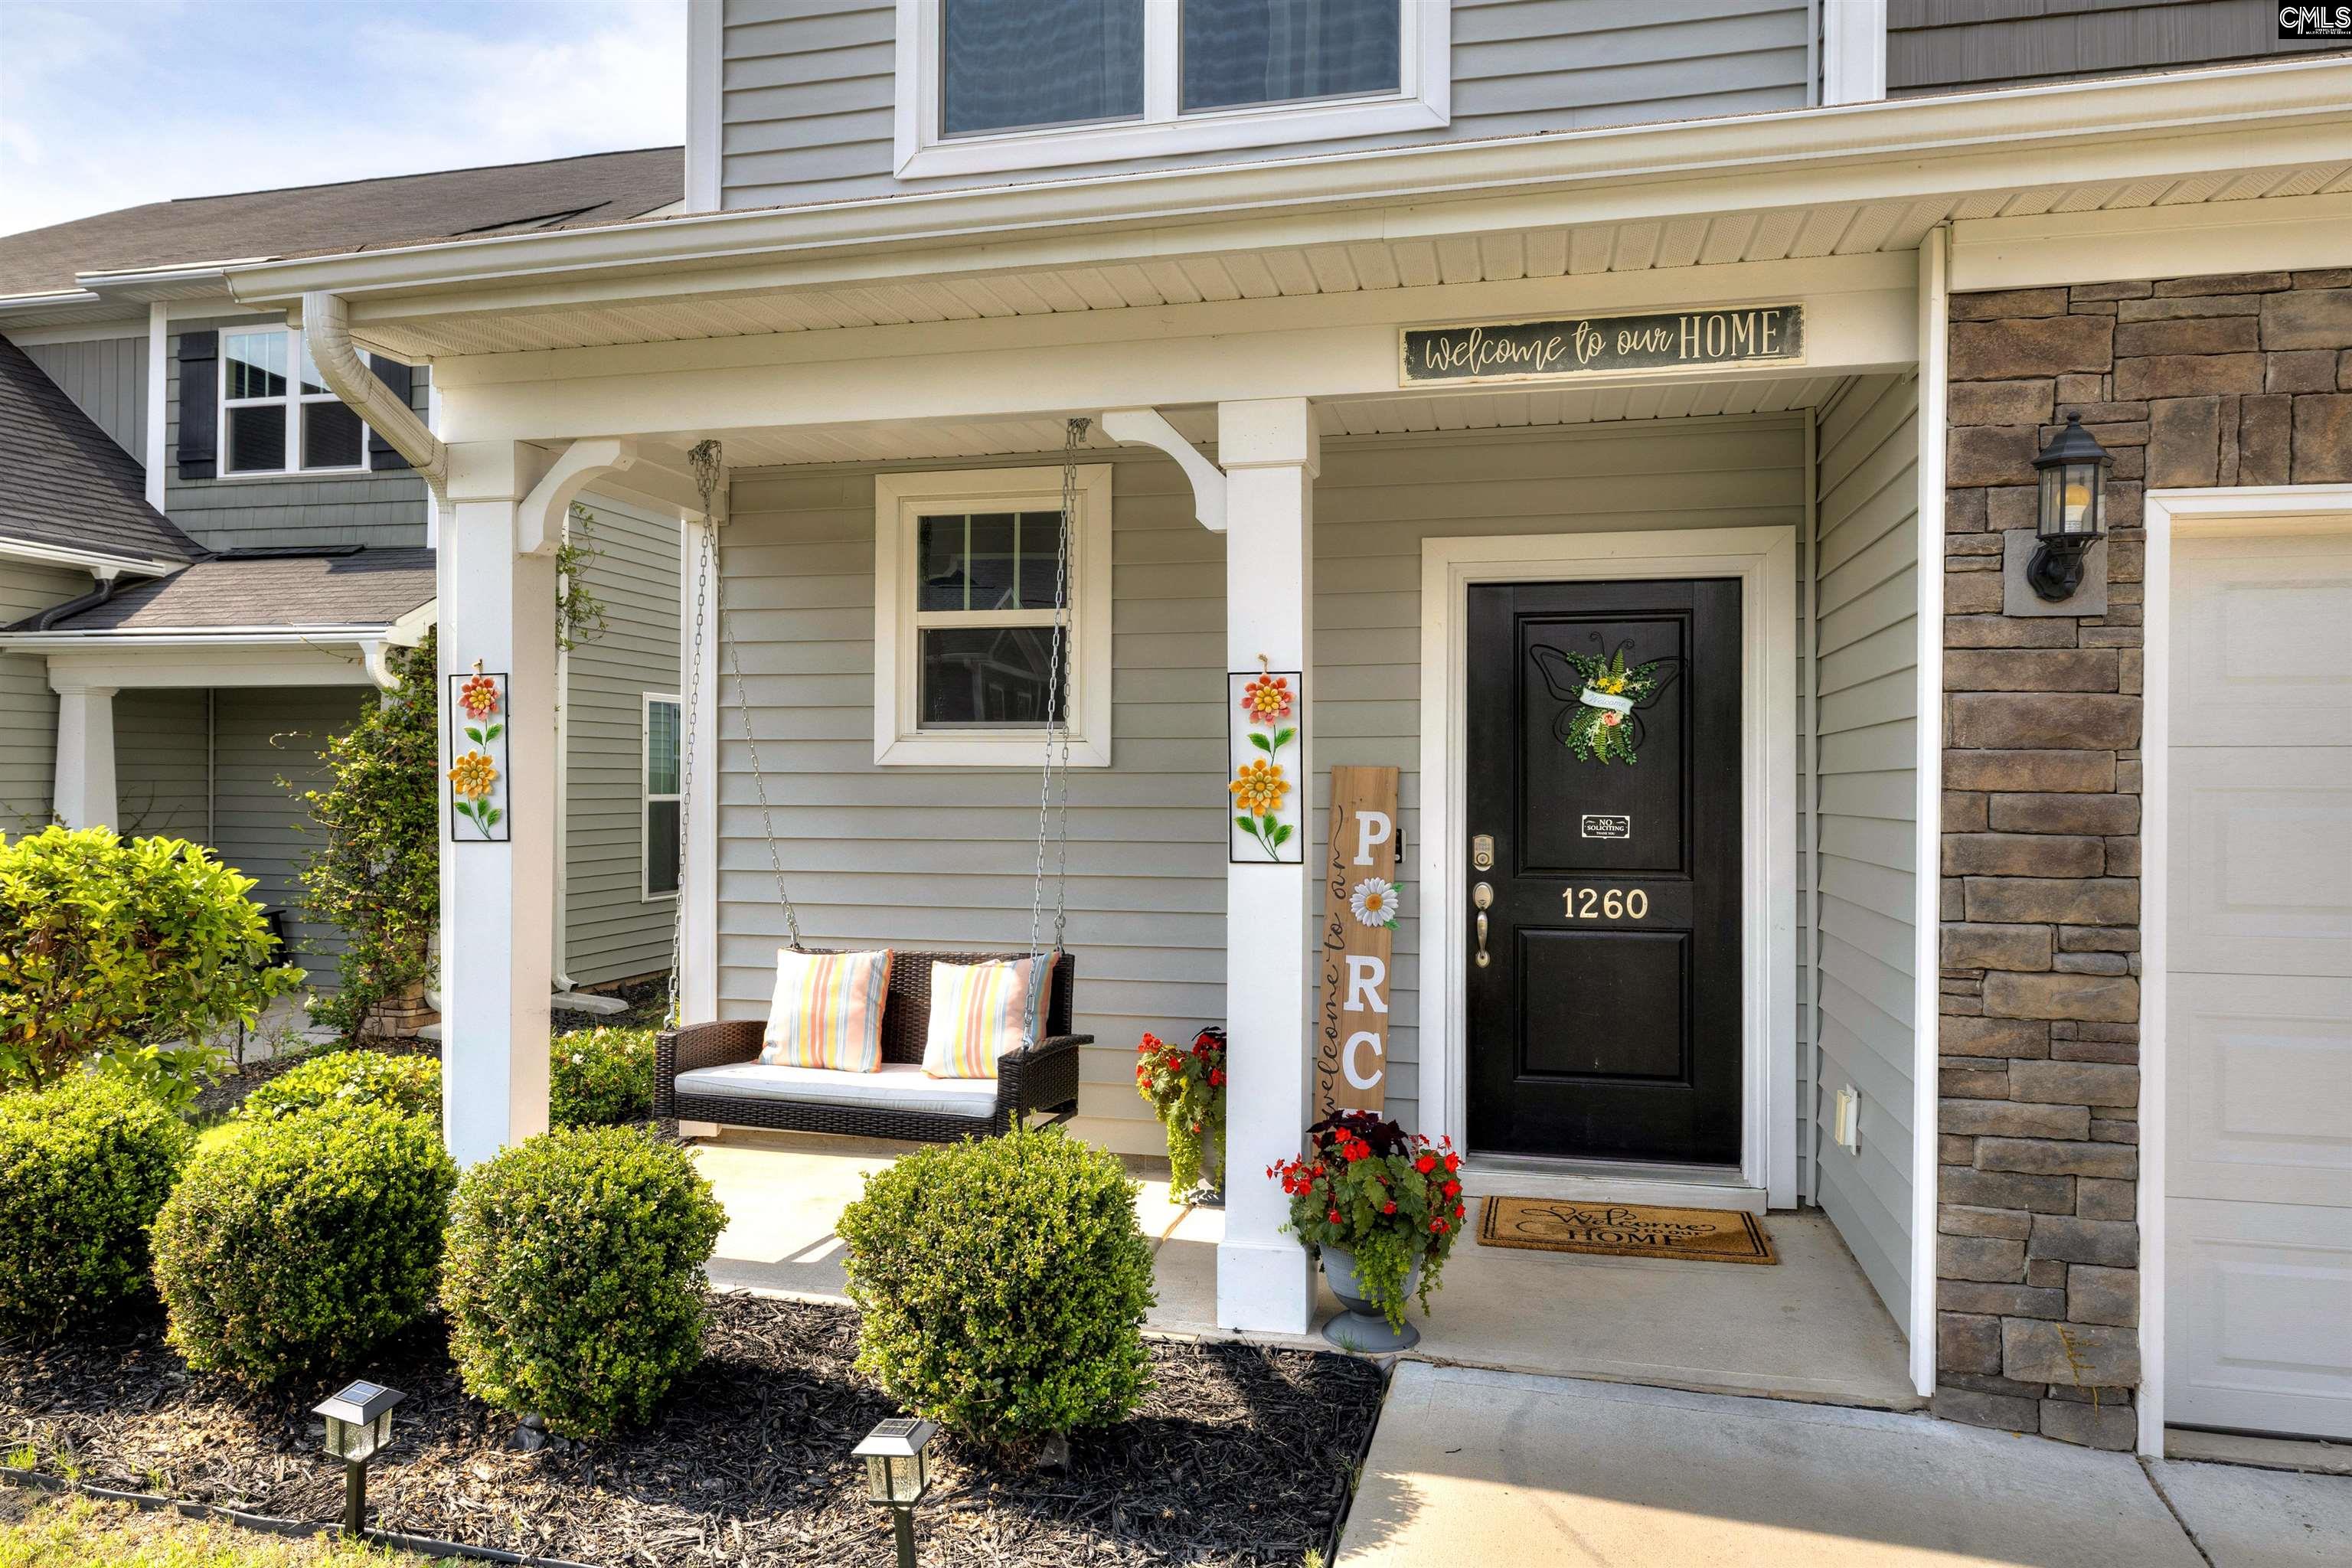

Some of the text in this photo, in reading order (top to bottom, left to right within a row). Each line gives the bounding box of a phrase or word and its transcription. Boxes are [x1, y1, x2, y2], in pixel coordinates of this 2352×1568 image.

[1426, 310, 1780, 374] welcome to our HOME
[1331, 804, 1347, 900] our
[1562, 887, 1648, 920] 1260
[1324, 912, 1345, 962] to
[1521, 1207, 1716, 1233] Welcome
[1567, 1229, 1685, 1246] HOME
